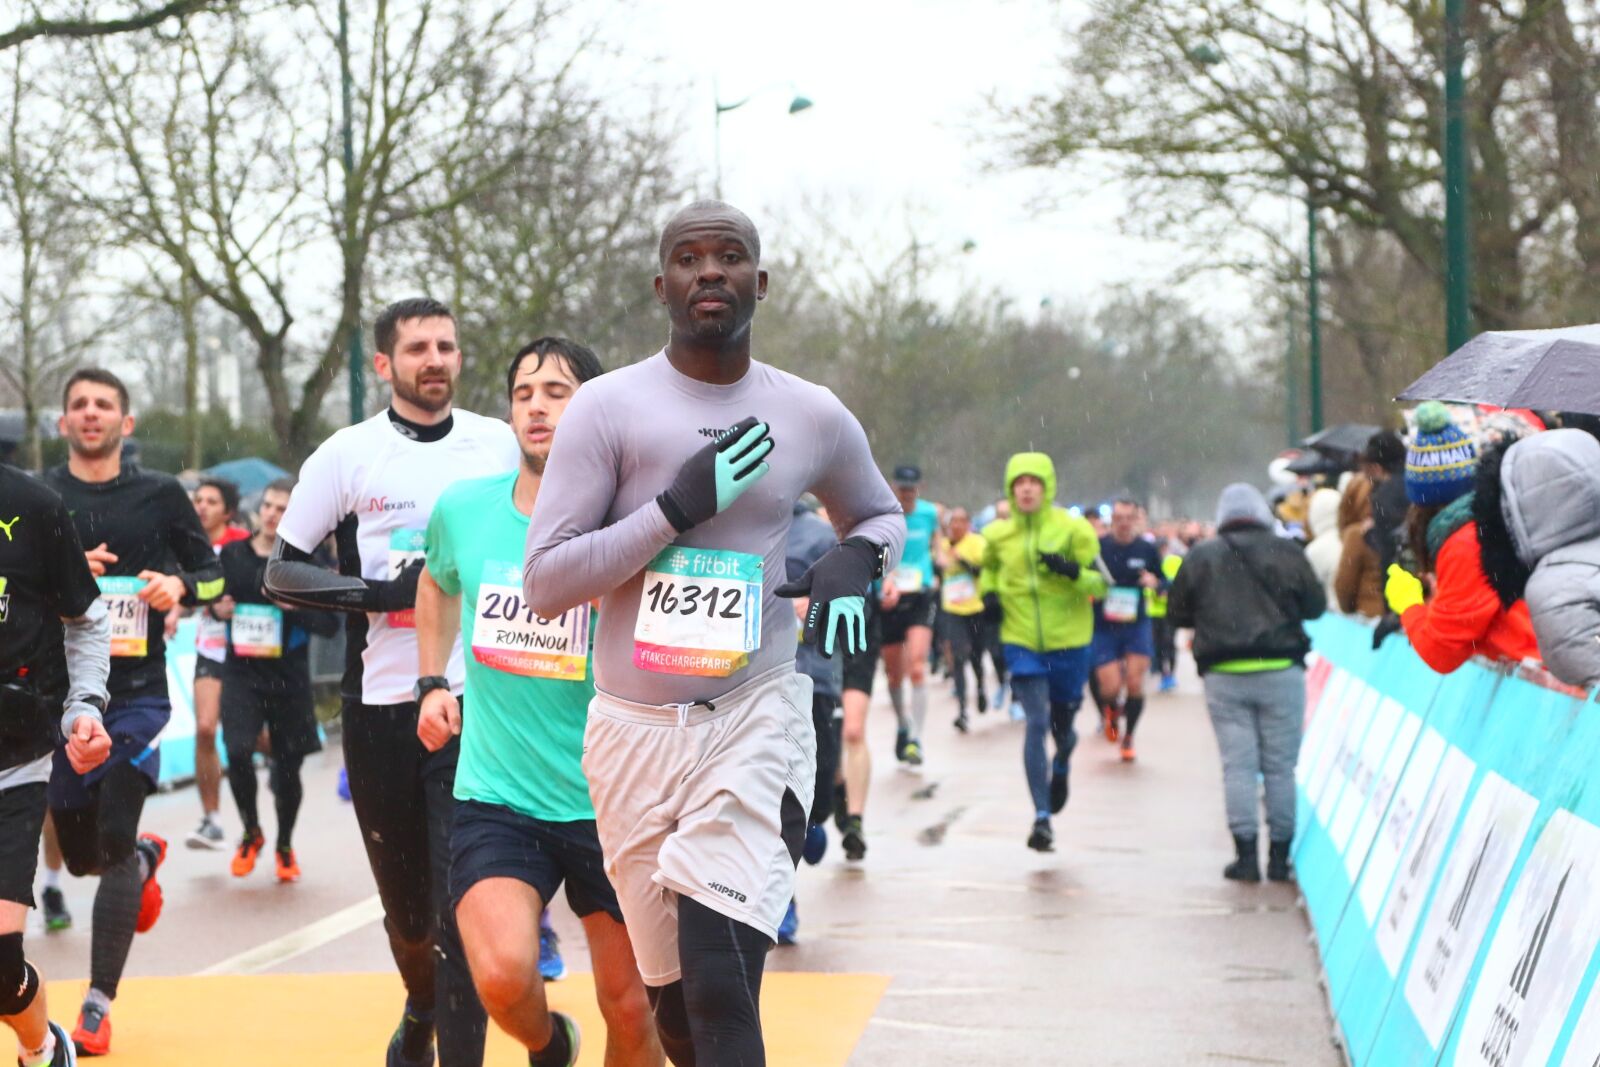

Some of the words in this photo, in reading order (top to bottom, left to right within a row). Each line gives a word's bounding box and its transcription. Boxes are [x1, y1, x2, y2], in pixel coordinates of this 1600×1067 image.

[369, 496, 416, 512] Nexans
[692, 554, 740, 576] fitbit
[647, 581, 742, 618] 16312
[808, 602, 820, 628] KIPSTA
[639, 648, 732, 670] #TAKECHARGEPARIS
